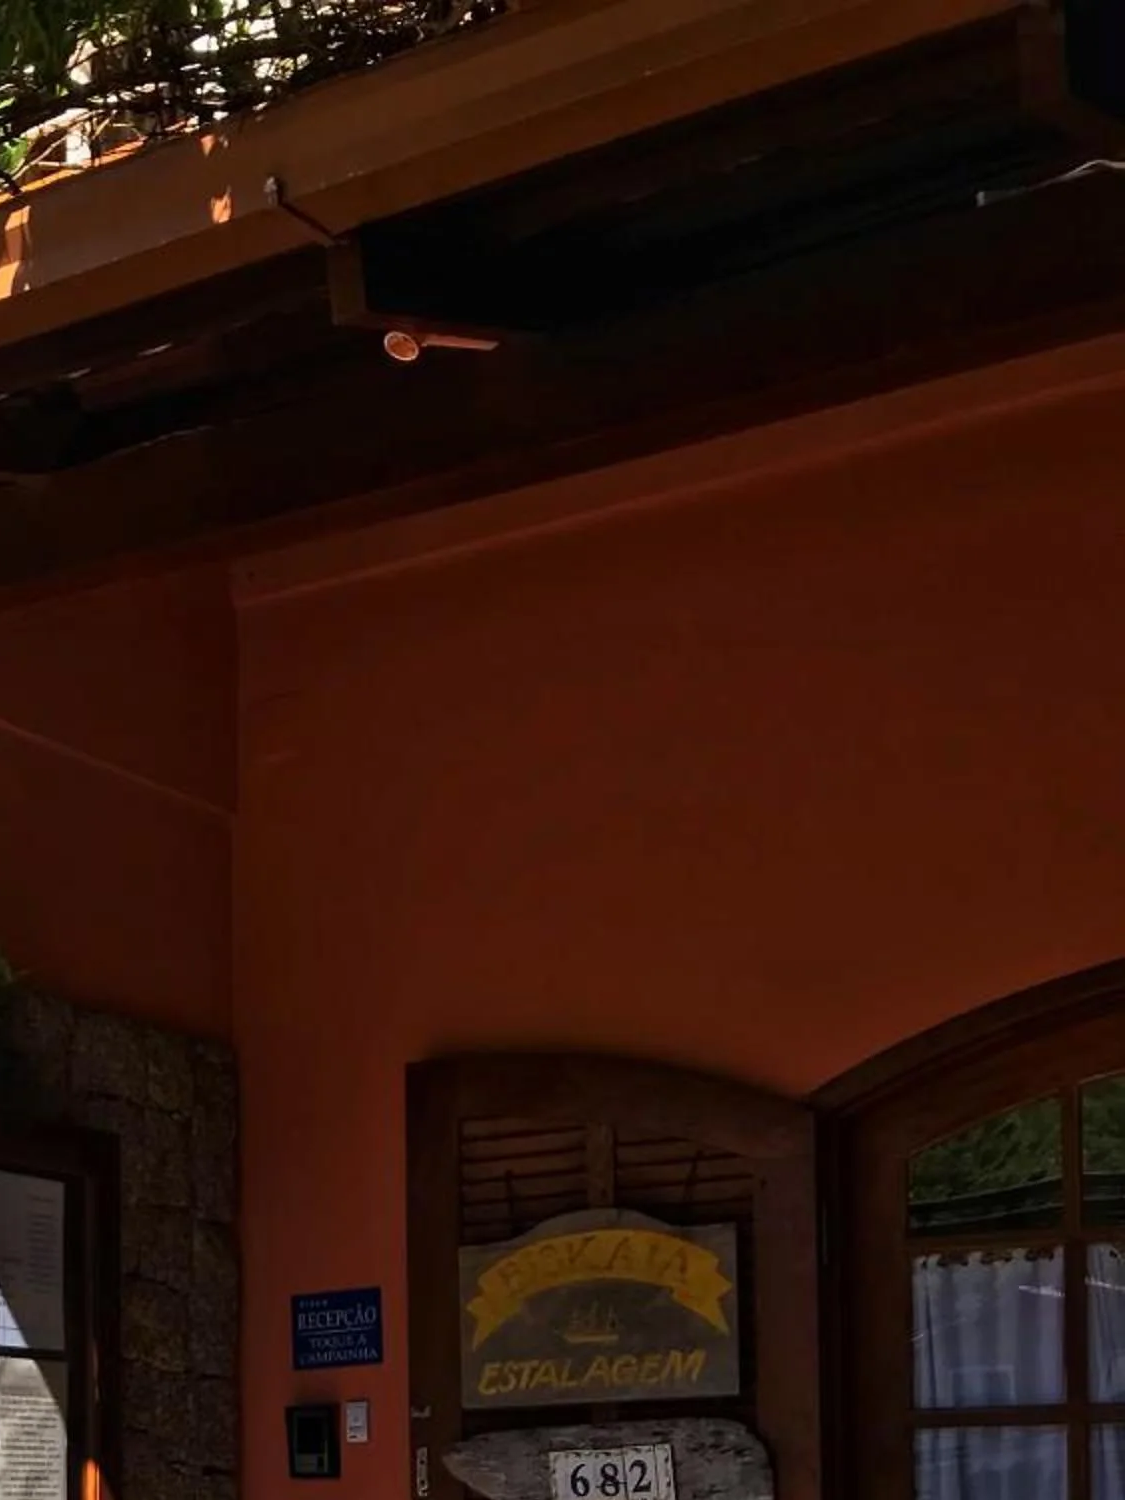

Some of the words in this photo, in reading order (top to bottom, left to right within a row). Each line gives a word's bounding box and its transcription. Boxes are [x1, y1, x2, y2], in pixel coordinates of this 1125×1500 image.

[297, 1302, 377, 1328] RECEPÇÃO
[299, 1346, 378, 1364] CAMPAINHA
[477, 1347, 707, 1396] ESTALAGEM
[570, 1459, 652, 1497] 682
